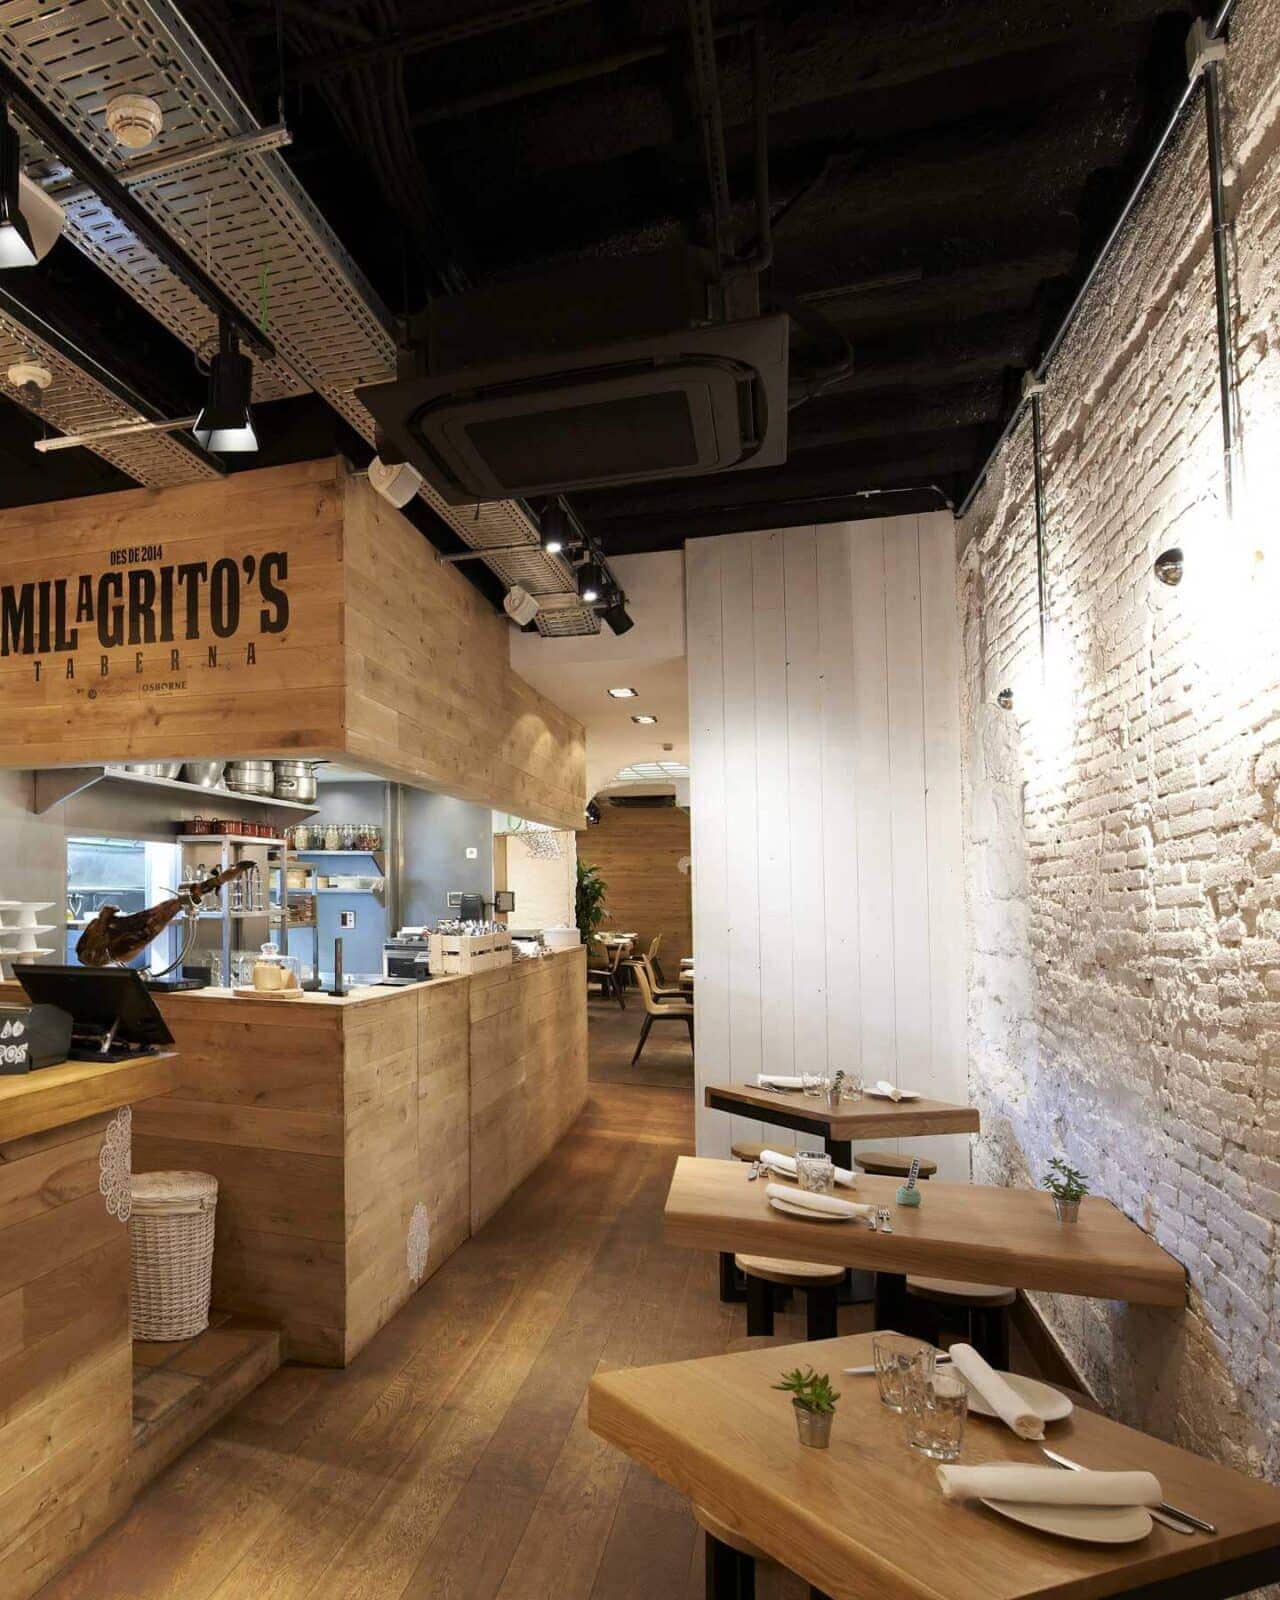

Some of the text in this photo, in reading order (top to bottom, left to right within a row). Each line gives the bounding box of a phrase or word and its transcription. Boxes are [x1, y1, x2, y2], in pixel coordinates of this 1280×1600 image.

[141, 544, 162, 562] 2014
[0, 551, 290, 657] MILAGRITO'S
[33, 642, 256, 682] TABERNA
[142, 680, 188, 692] OSBORNE
